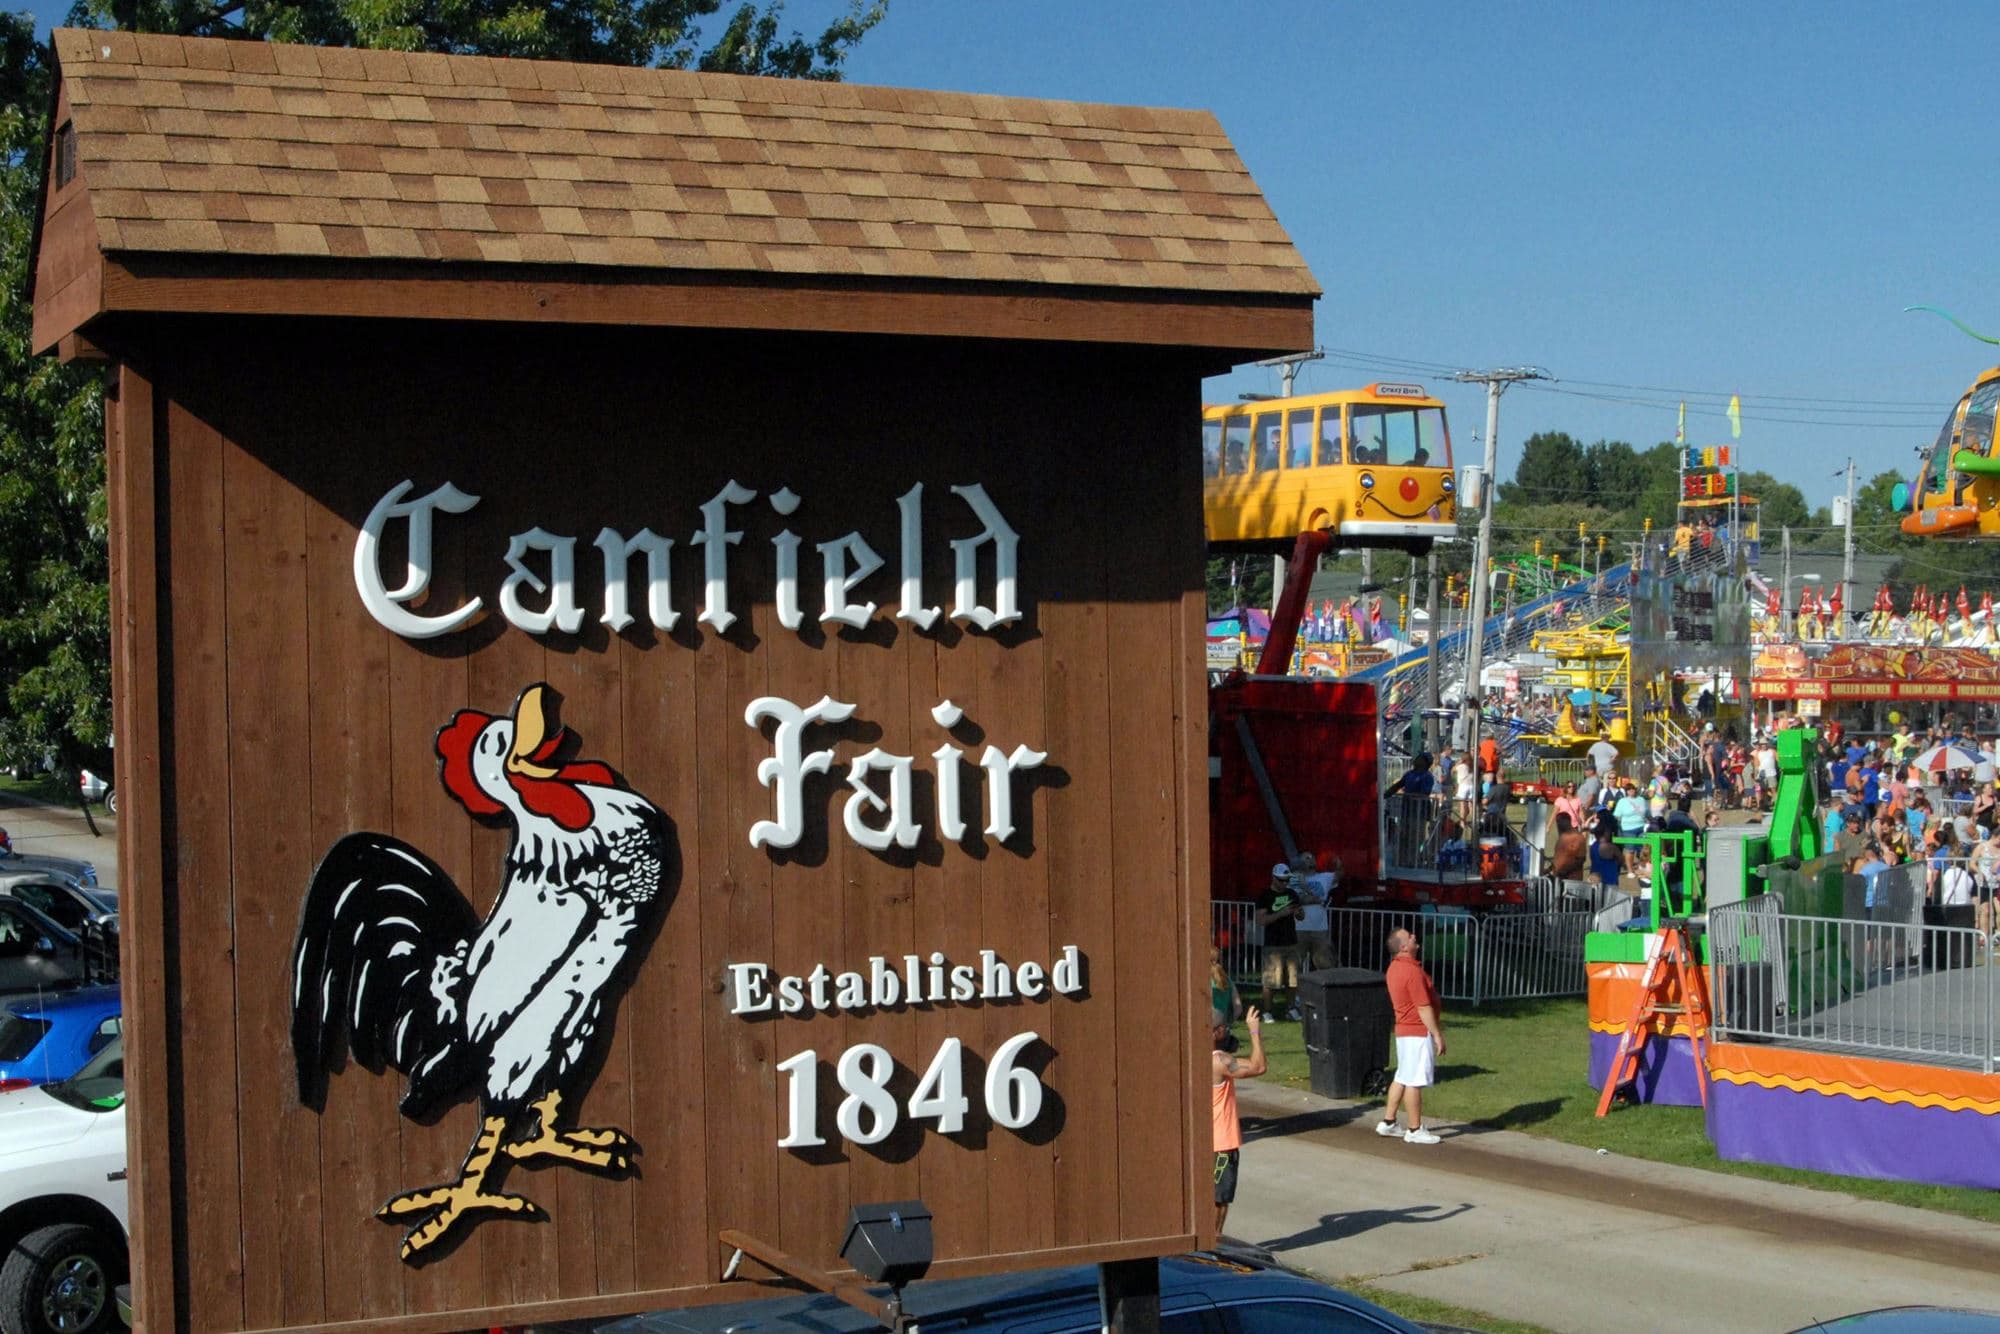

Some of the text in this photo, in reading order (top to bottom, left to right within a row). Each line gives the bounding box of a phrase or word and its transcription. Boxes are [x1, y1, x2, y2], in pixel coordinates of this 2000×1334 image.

[1684, 473, 1735, 497] SLIDE
[1689, 446, 1729, 468] FUN
[353, 479, 1024, 639] Canfield
[745, 695, 1048, 850] Fair
[728, 945, 1083, 1015] Established
[777, 1031, 1043, 1148] 1846
